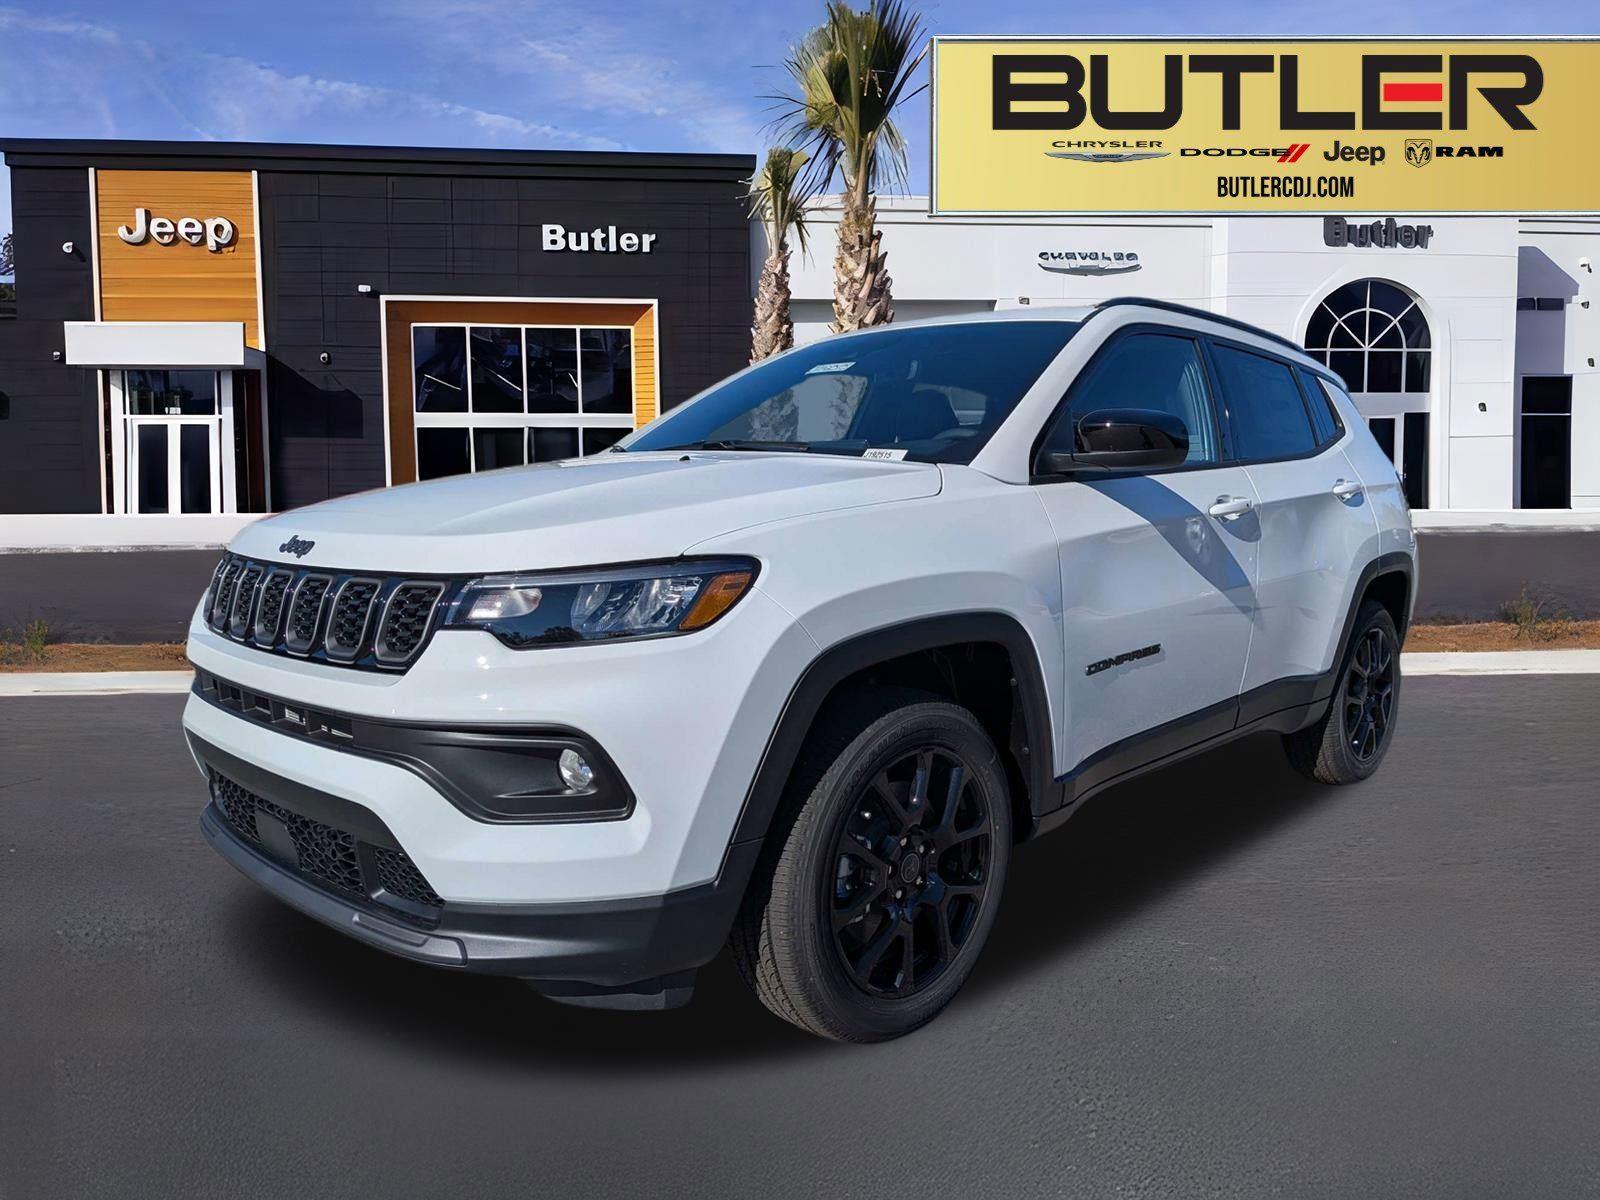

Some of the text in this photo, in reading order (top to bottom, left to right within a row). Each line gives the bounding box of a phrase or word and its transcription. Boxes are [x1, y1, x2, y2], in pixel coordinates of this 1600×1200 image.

[118, 208, 235, 251] Jeep
[541, 224, 656, 253] Butler
[279, 535, 315, 559] Jeep
